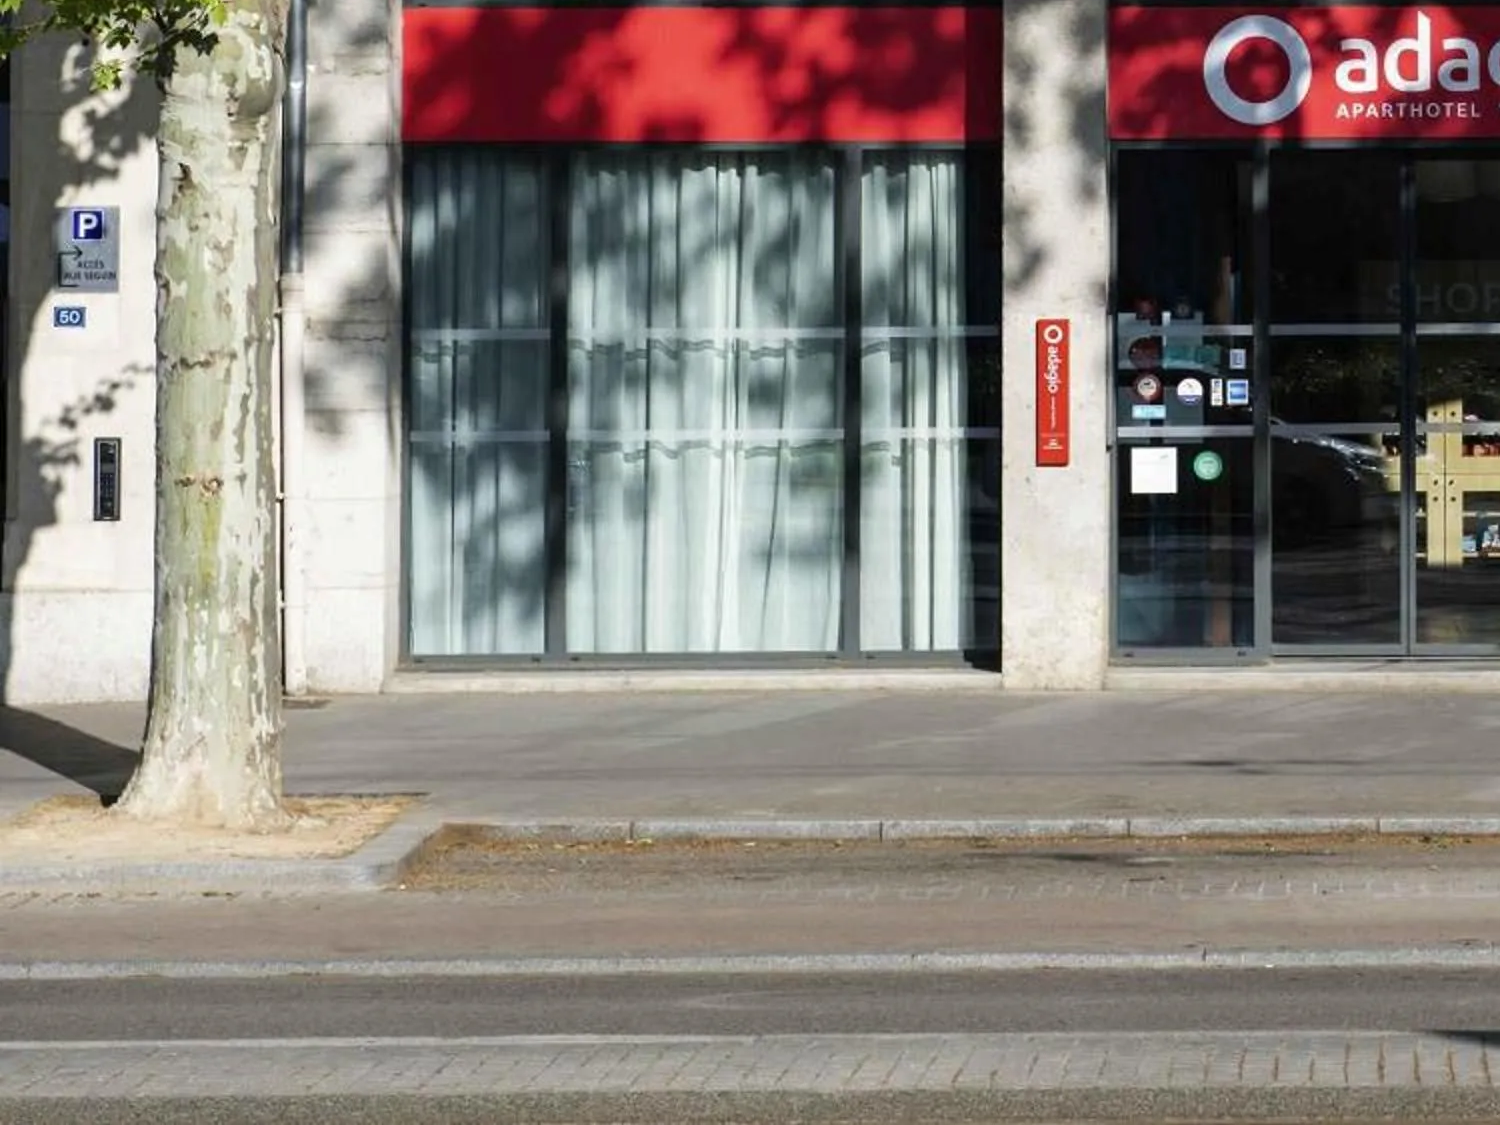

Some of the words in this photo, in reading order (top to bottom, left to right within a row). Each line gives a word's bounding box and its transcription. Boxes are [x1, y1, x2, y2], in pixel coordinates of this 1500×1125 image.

[1336, 103, 1480, 119] APARTHOTEL
[79, 214, 98, 238] P
[59, 310, 81, 324] 50
